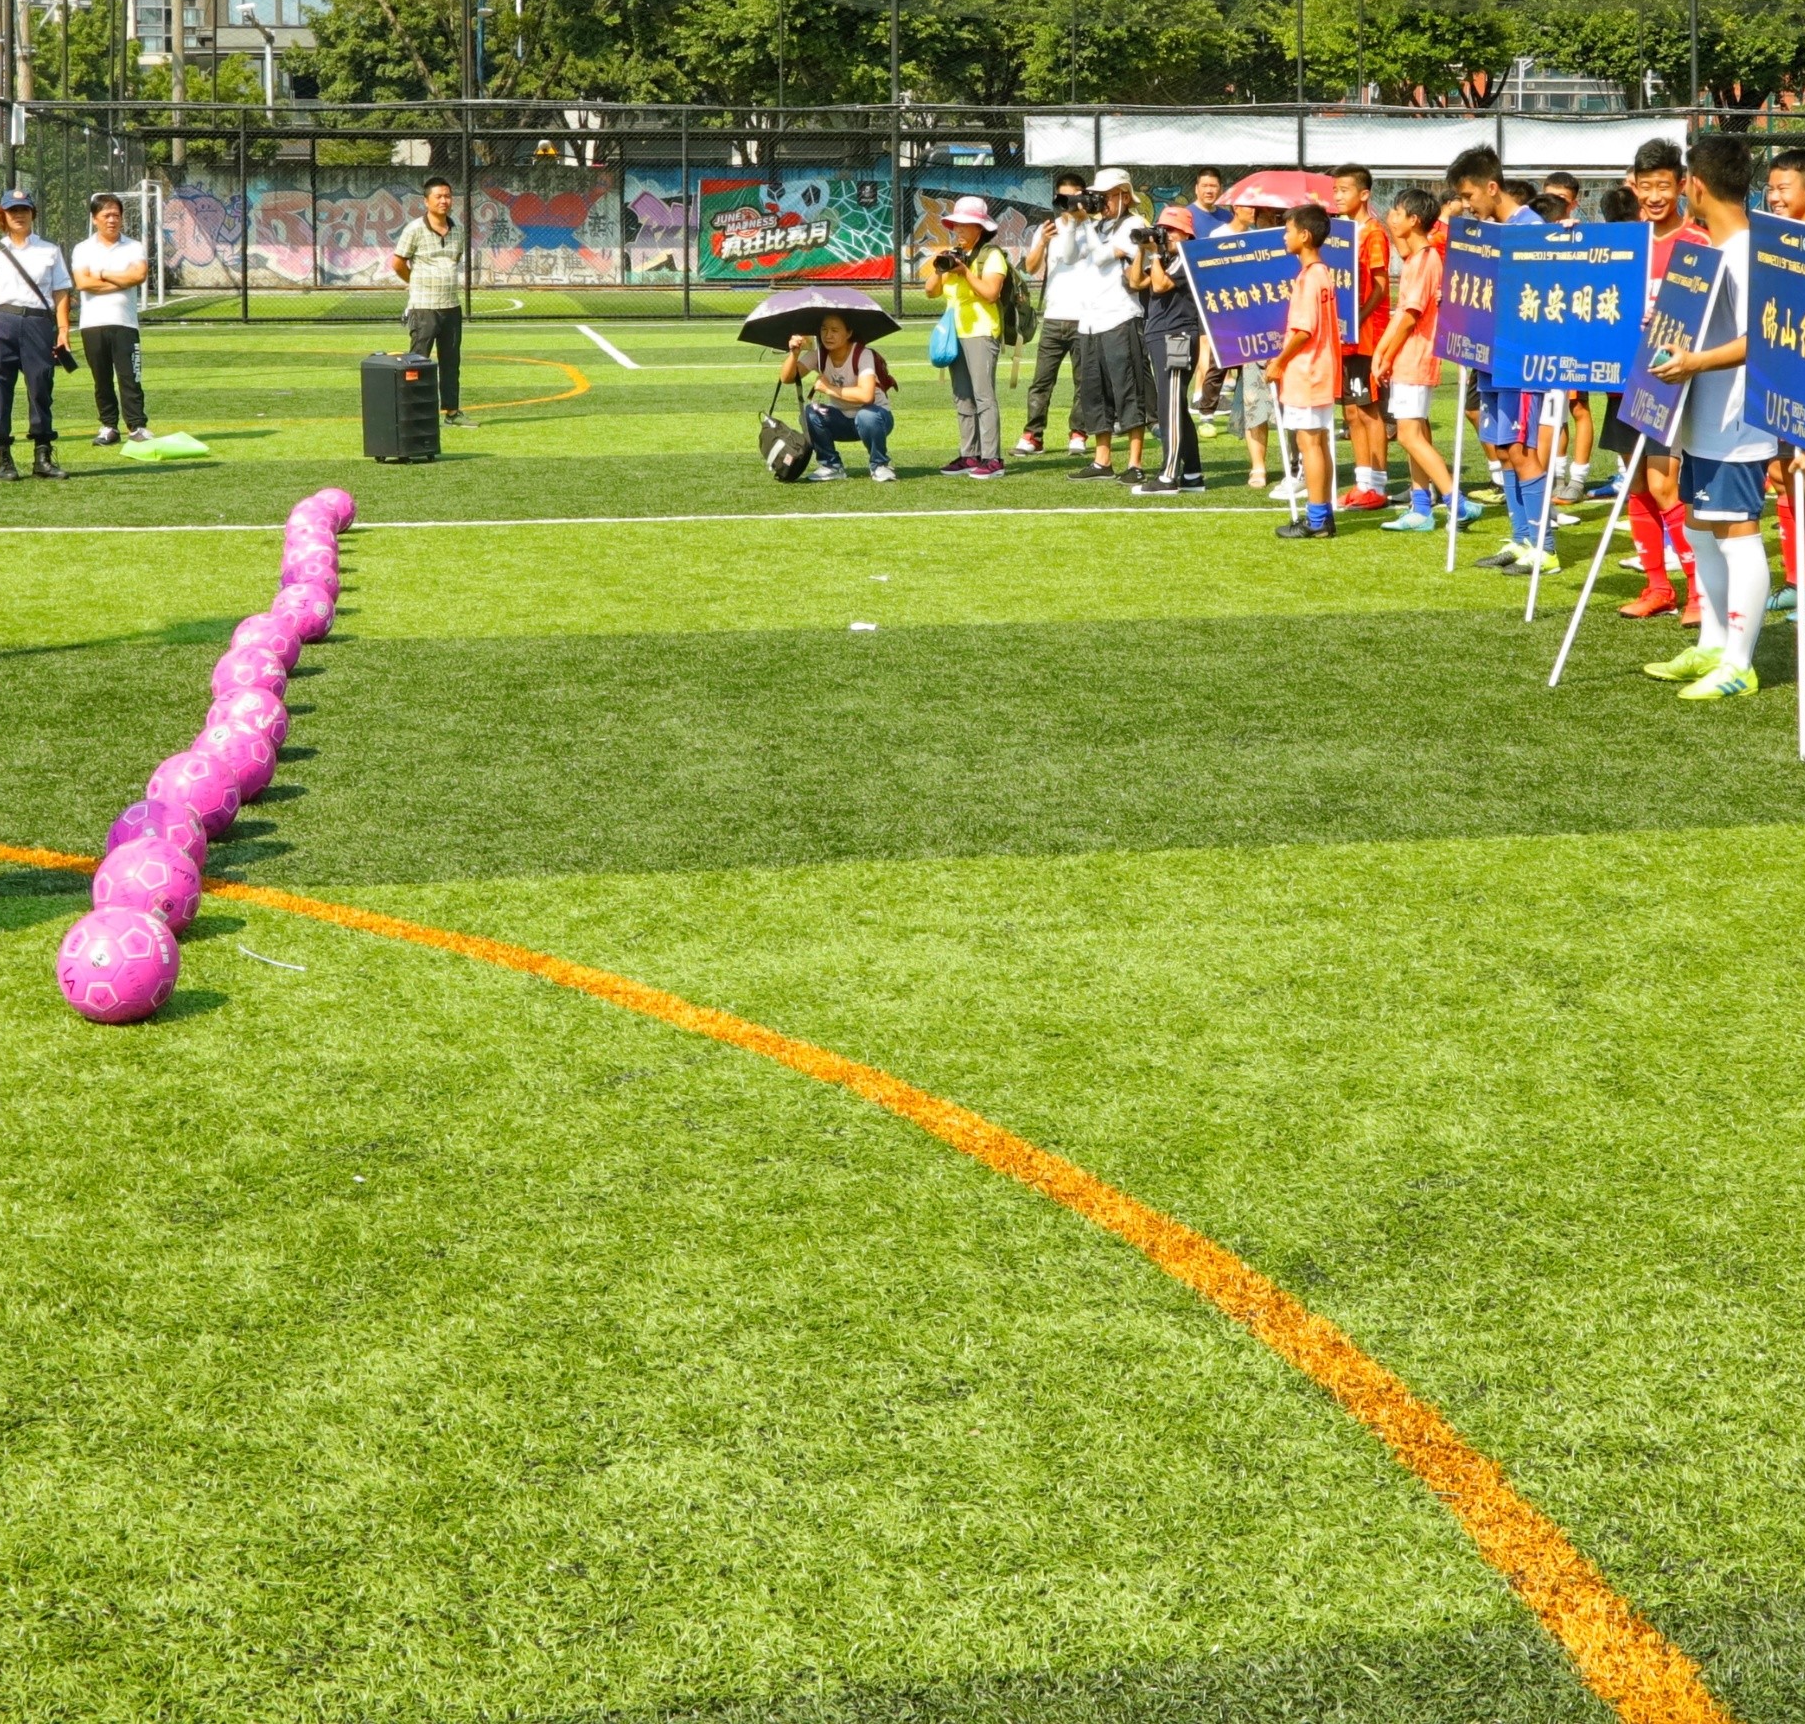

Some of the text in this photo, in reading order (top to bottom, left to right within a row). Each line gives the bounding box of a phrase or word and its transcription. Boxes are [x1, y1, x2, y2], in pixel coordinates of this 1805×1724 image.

[714, 213, 742, 226] JUNE
[727, 216, 777, 234] MADNESS
[722, 220, 829, 259] 疯狂比赛月
[1588, 247, 1610, 264] U15
[1518, 283, 1621, 326] 新安明珠
[1238, 332, 1269, 358] U15
[1522, 355, 1557, 383] U15
[1590, 361, 1622, 384] 足球
[1766, 390, 1790, 433] U15
